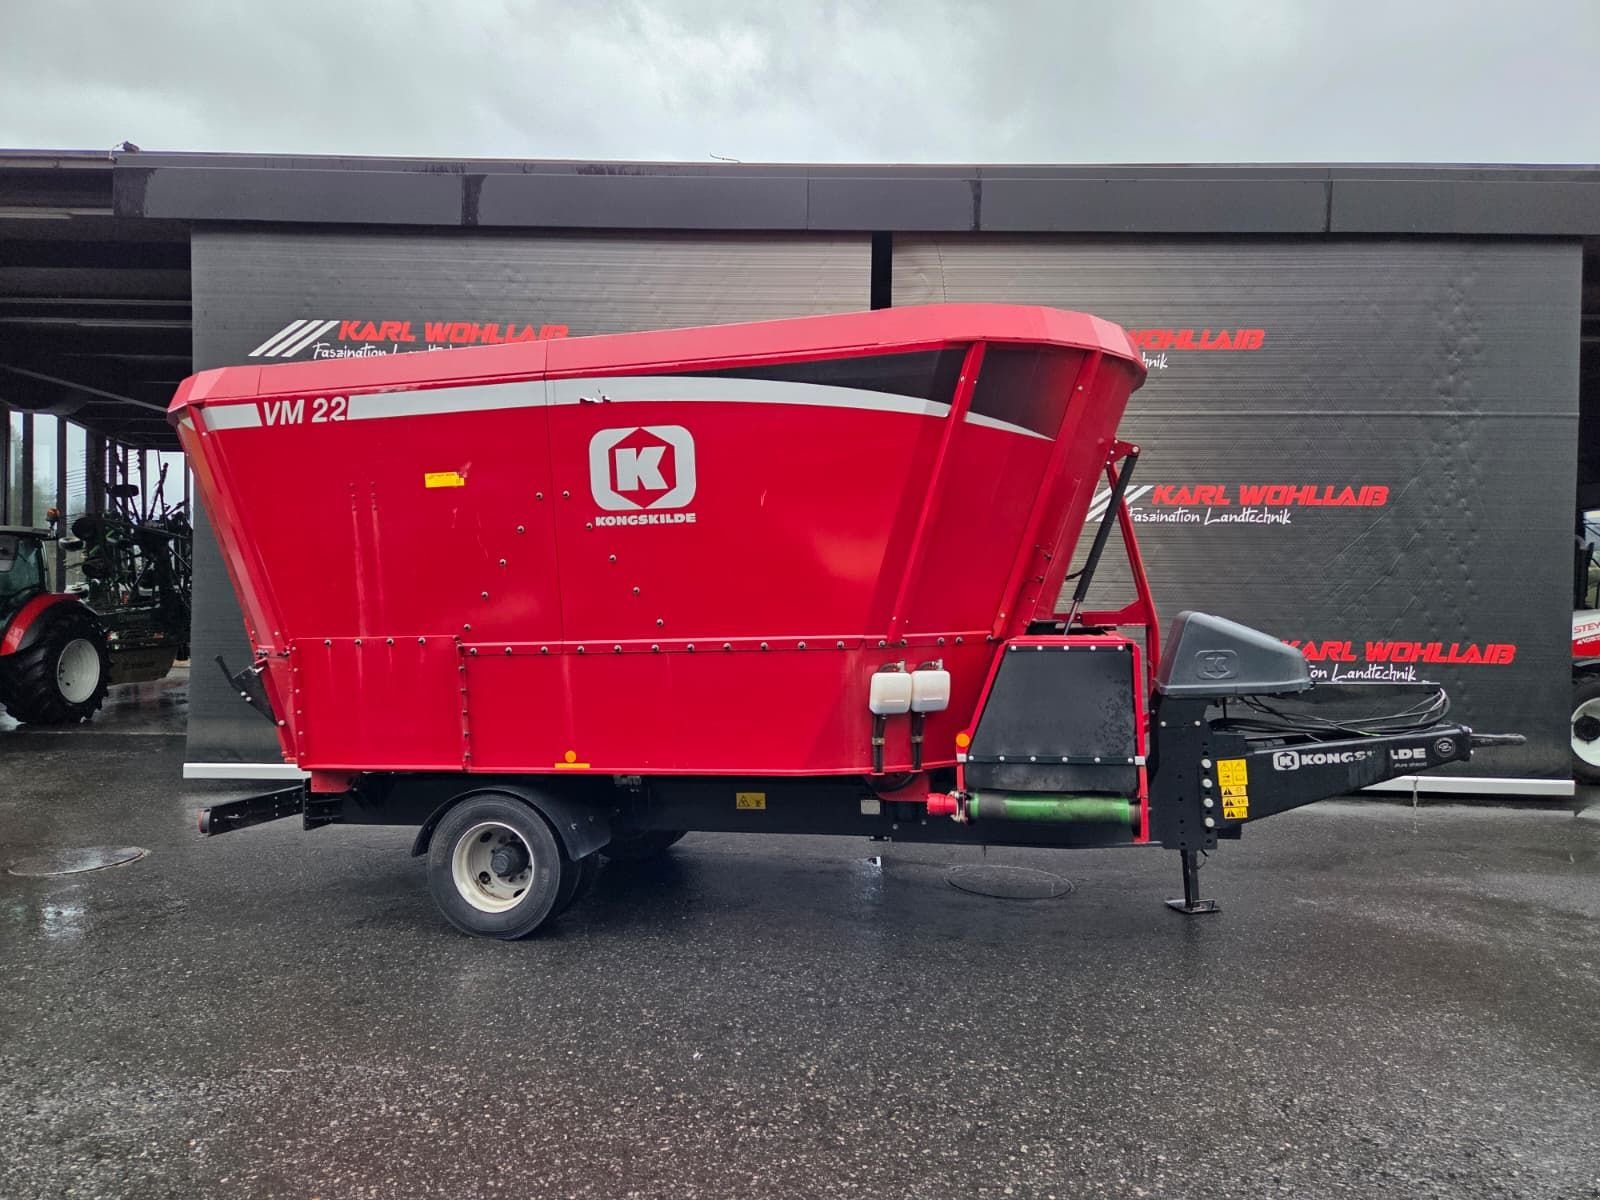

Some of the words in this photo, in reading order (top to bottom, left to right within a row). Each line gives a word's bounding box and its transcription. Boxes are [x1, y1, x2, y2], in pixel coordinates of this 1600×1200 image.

[338, 319, 416, 342] KARL
[312, 341, 387, 360] Faszination
[263, 399, 305, 426] VM
[311, 396, 346, 423] 22
[615, 446, 669, 491] K
[1151, 485, 1231, 506] KARL
[1238, 485, 1390, 507] WOHLLAIB
[595, 512, 697, 527] KONGSKILDE
[1203, 507, 1292, 526] Landtechnik
[1364, 640, 1516, 665] WOHLLAIB
[1331, 663, 1417, 682] Landtechnik
